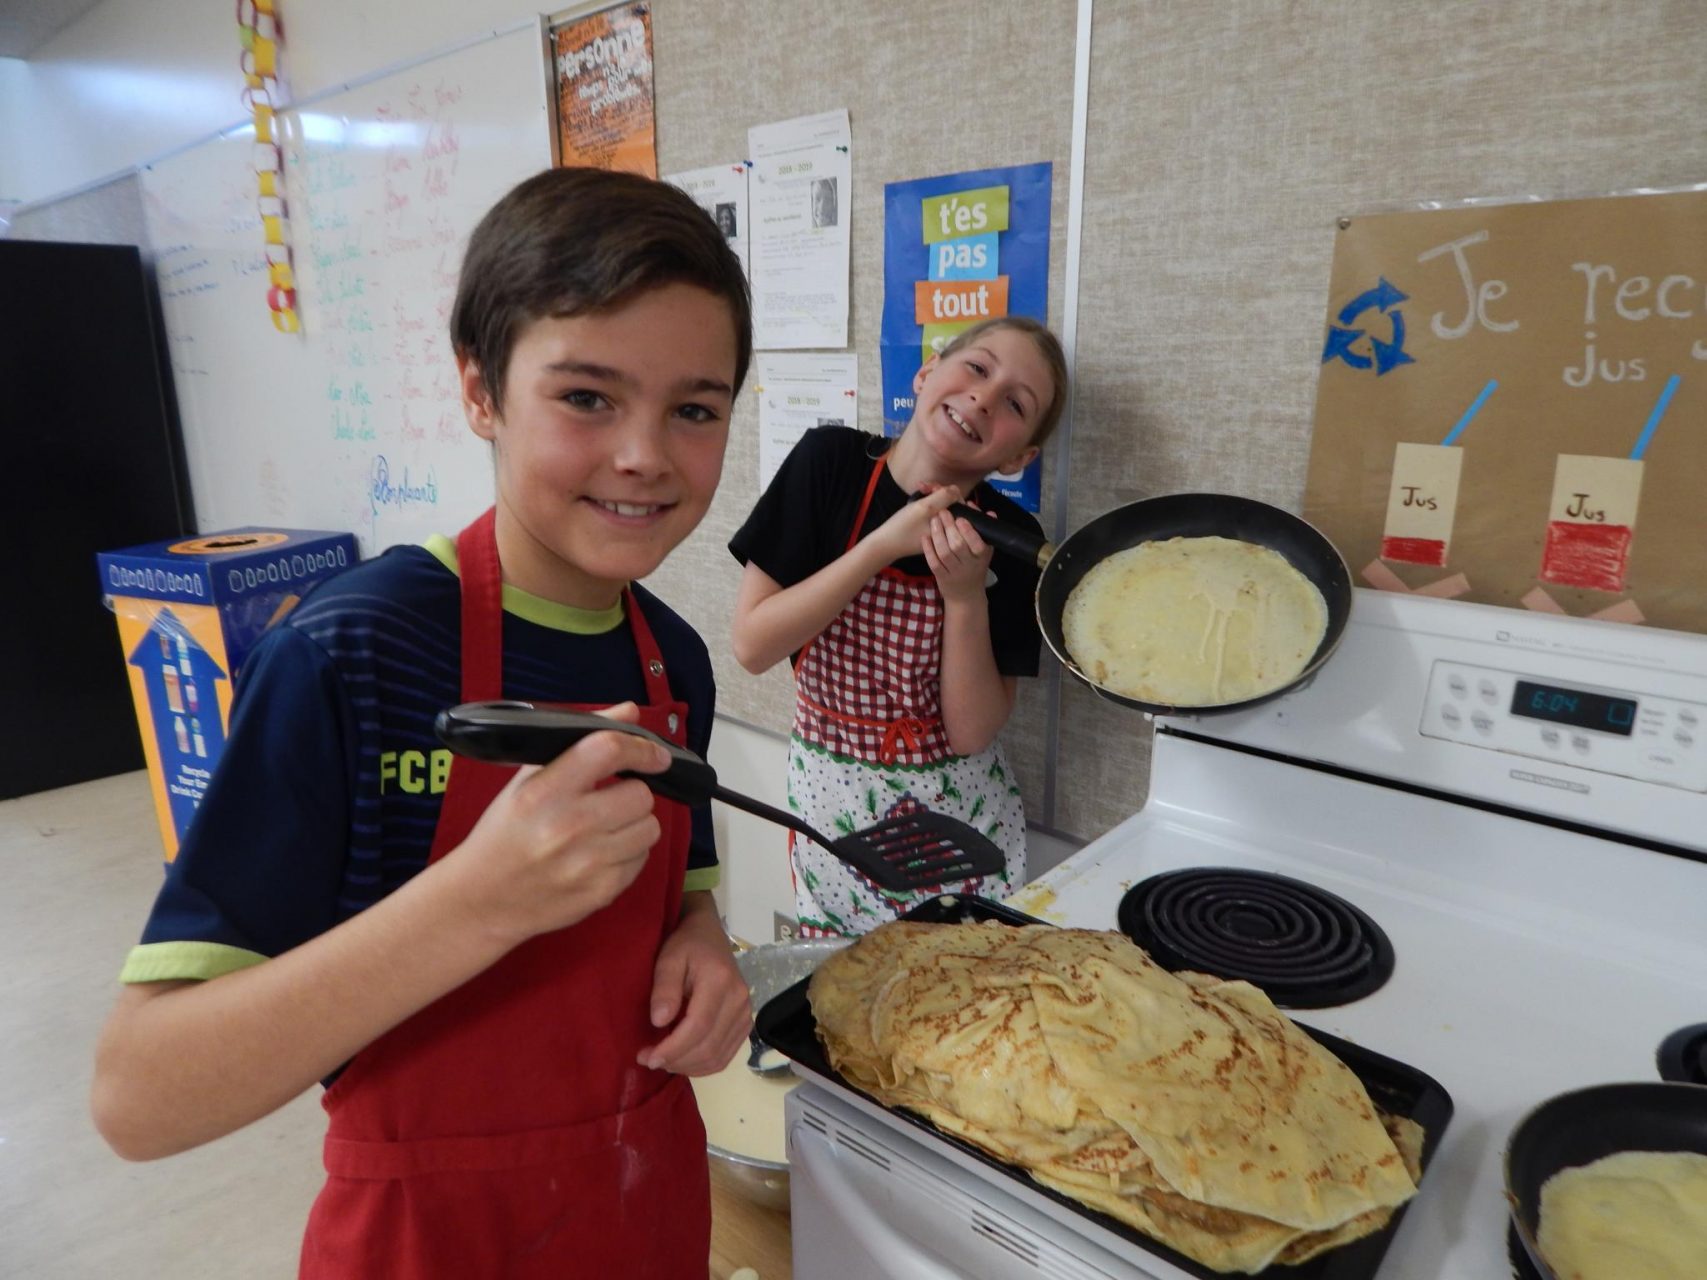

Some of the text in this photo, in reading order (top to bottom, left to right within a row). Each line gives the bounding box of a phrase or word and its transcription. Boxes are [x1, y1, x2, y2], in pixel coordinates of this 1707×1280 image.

[939, 198, 988, 235] t'es
[937, 242, 988, 278] pas
[932, 285, 990, 319] tout
[1417, 229, 1520, 340] Je
[1562, 331, 1646, 388] jus
[1400, 486, 1438, 511] Jus
[1565, 493, 1606, 522] Jus
[381, 748, 455, 796] FCB
